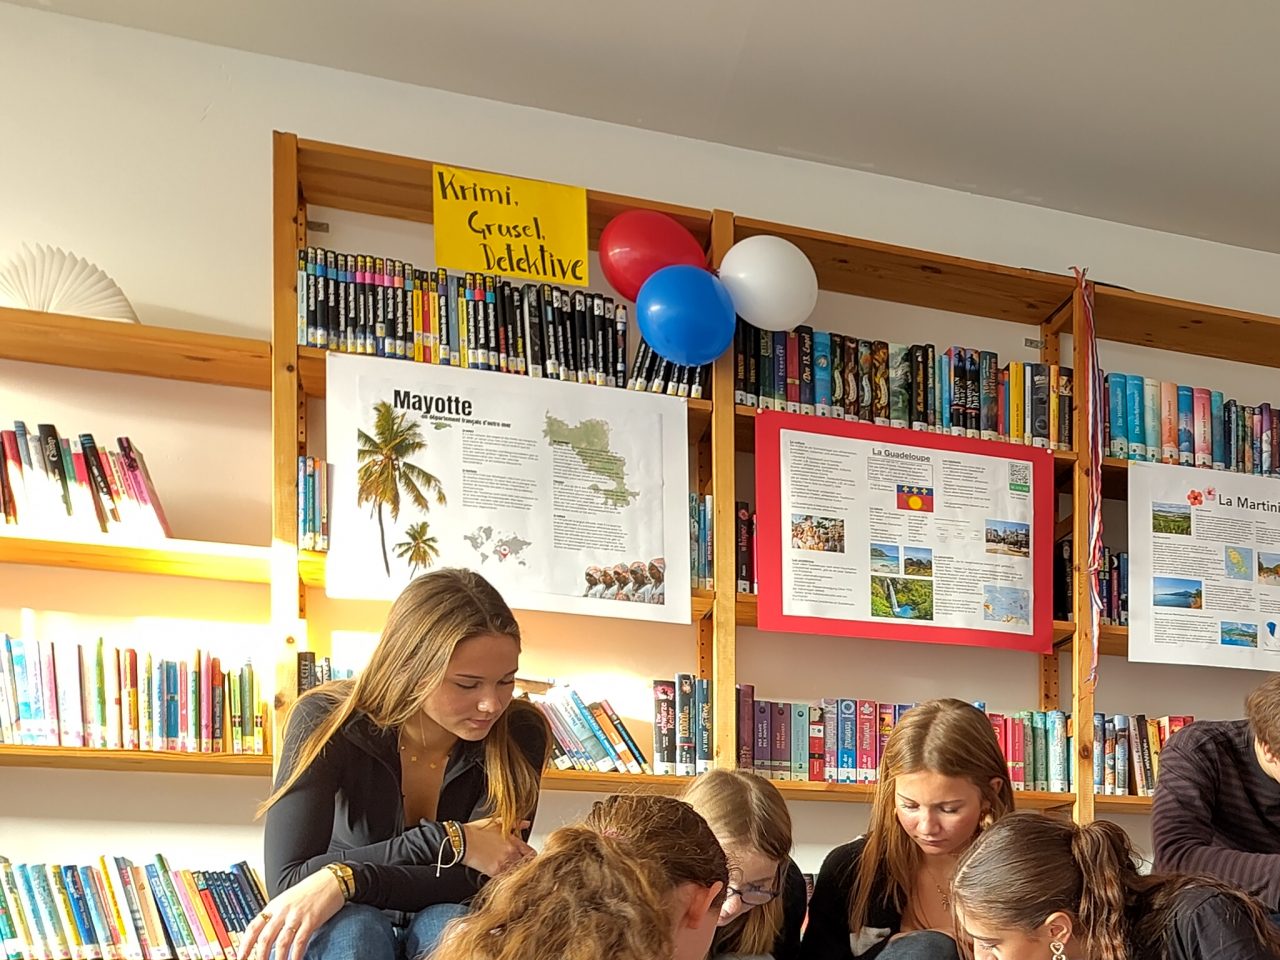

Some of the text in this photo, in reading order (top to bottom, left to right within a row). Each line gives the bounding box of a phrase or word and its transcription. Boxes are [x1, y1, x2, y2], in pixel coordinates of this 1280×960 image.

[437, 170, 519, 207] Krimi,
[482, 243, 584, 282] Detektive
[802, 333, 812, 353] Engel
[394, 390, 472, 416] Mayotte
[884, 450, 930, 462] Guadeloupe
[1218, 494, 1233, 507] La
